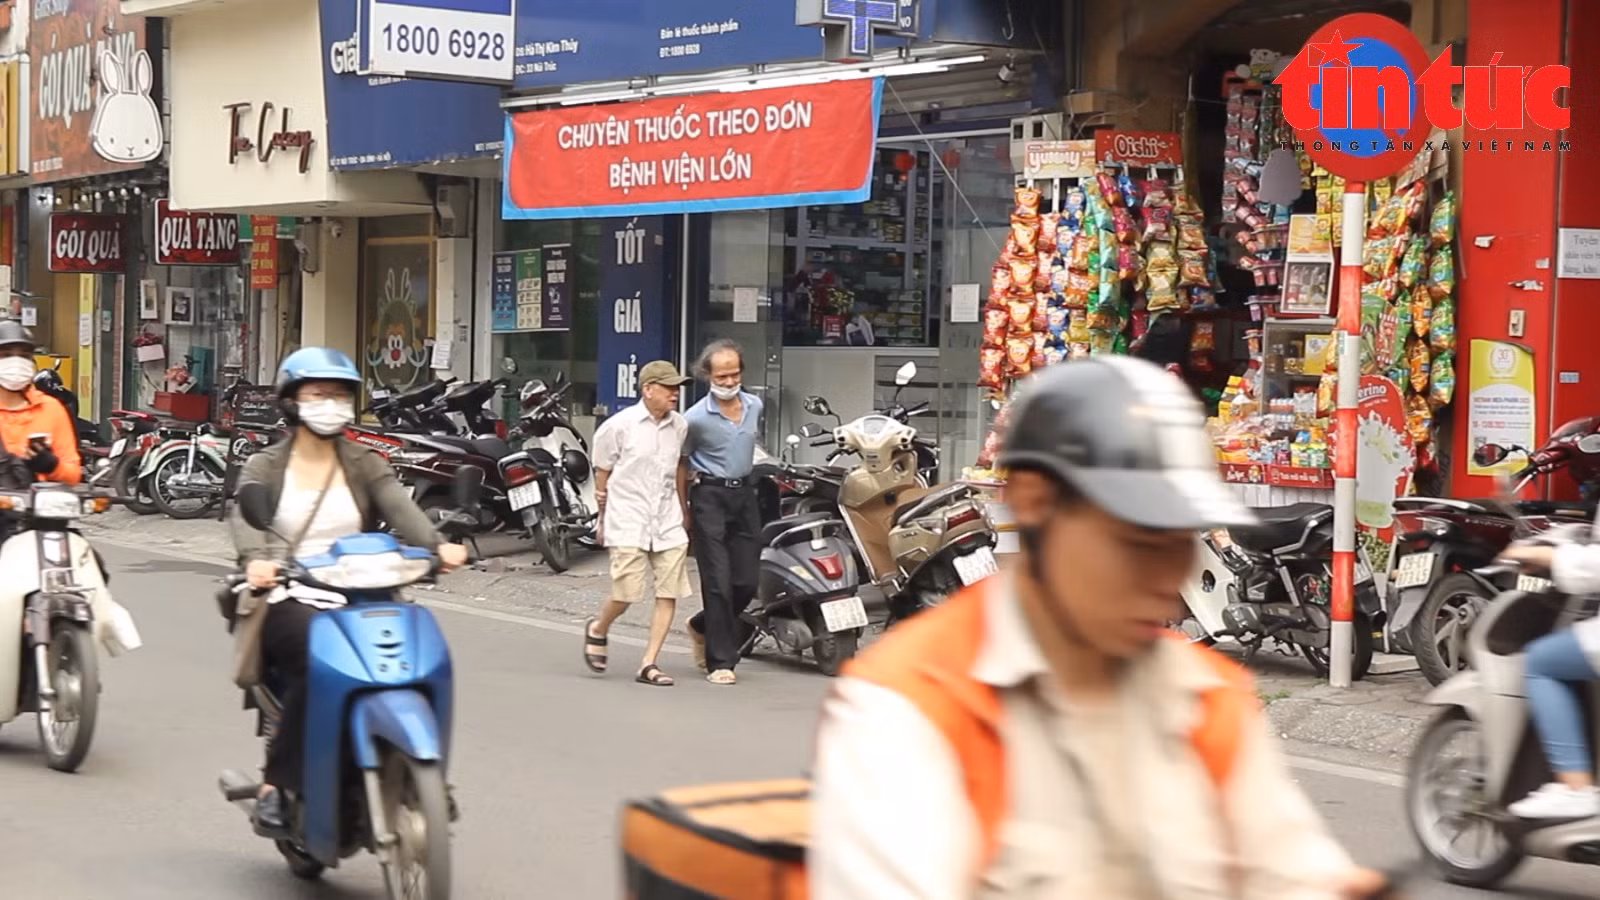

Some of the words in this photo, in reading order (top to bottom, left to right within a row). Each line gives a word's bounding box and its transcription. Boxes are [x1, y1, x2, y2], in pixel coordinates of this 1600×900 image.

[382, 22, 439, 55] 1800
[450, 28, 505, 61] 6928
[546, 41, 560, 54] Kim
[681, 23, 700, 36] thuốc
[39, 33, 63, 120] GÓI
[63, 22, 91, 129] QUÀ
[558, 112, 629, 149] CHUYÊN
[634, 103, 701, 143] THUỐC
[707, 111, 760, 137] THEO
[765, 101, 812, 132] ĐƠN
[1114, 133, 1160, 159] Oishi
[609, 156, 656, 194] BỆNH
[662, 153, 704, 190] VIỆN
[710, 148, 751, 182] LỚN
[1029, 150, 1081, 174] yummy
[56, 222, 85, 259] GÓI
[87, 222, 120, 265] QUÀ
[160, 211, 192, 256] QUÀ
[614, 217, 646, 264] TỐT
[614, 291, 642, 333] GIÁ
[617, 354, 637, 398] RẺ
[1358, 383, 1387, 399] erino
